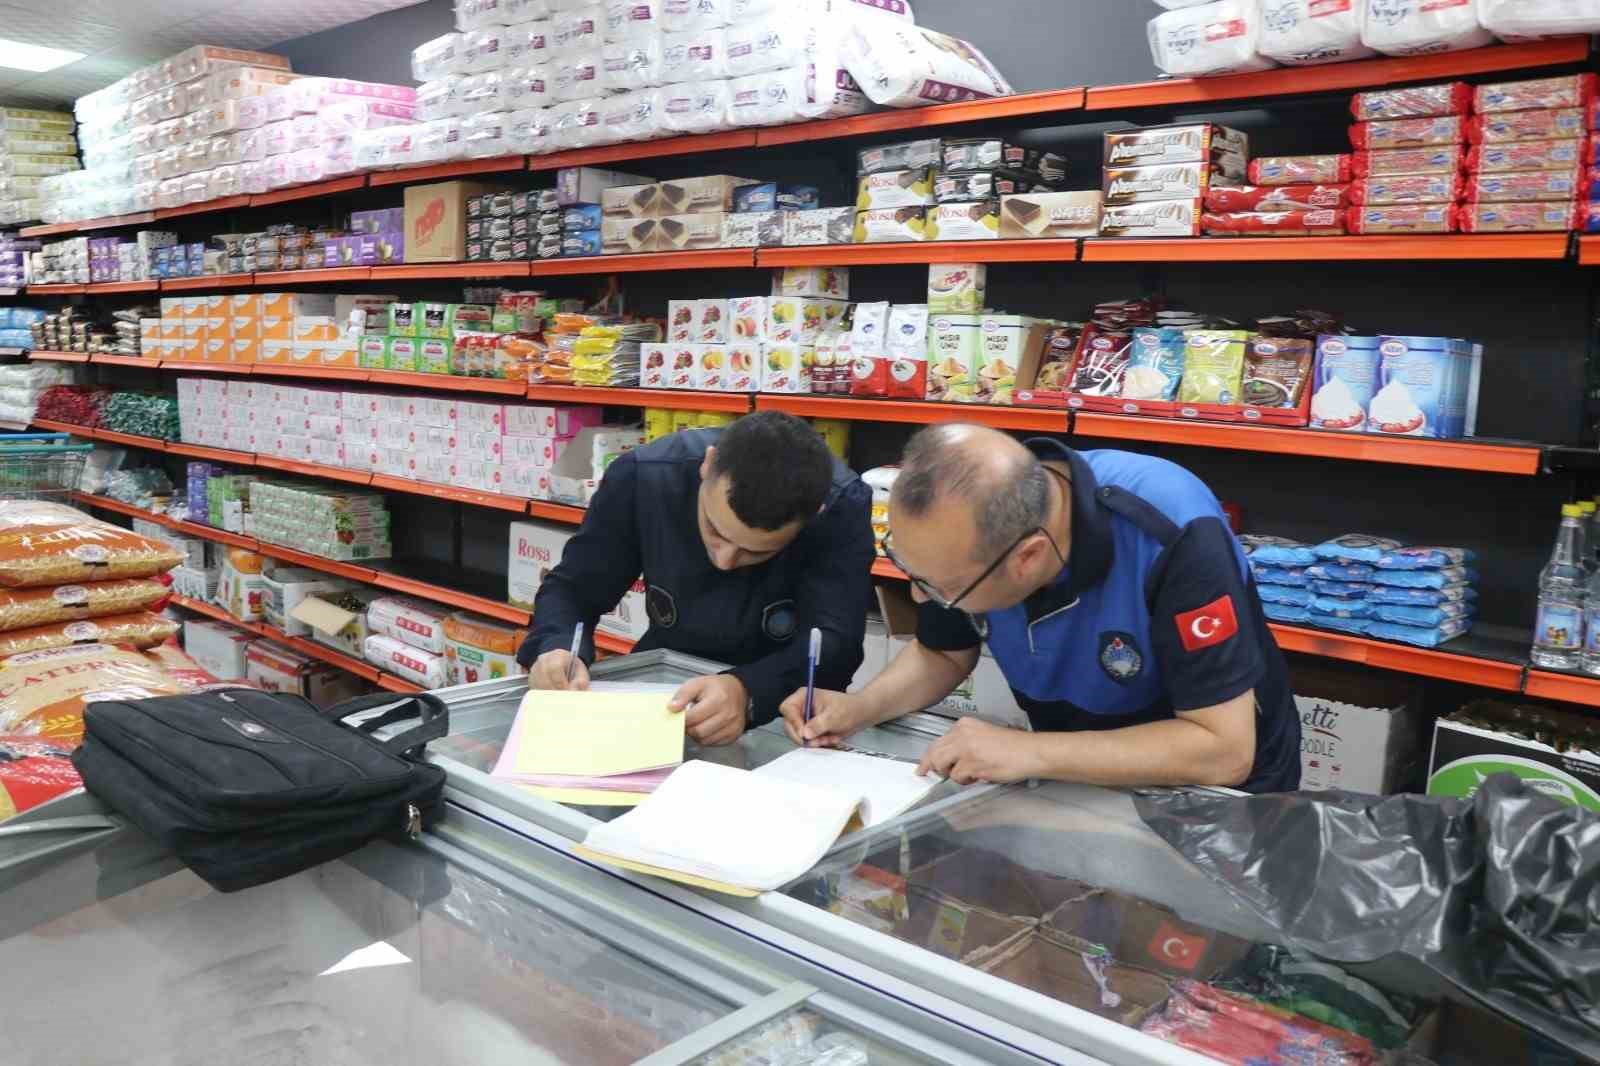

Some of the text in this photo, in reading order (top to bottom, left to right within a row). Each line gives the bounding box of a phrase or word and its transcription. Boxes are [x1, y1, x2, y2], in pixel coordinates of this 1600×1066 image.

[516, 537, 551, 562] Rosa
[1302, 703, 1340, 730] etti
[1299, 736, 1337, 758] OODLE
